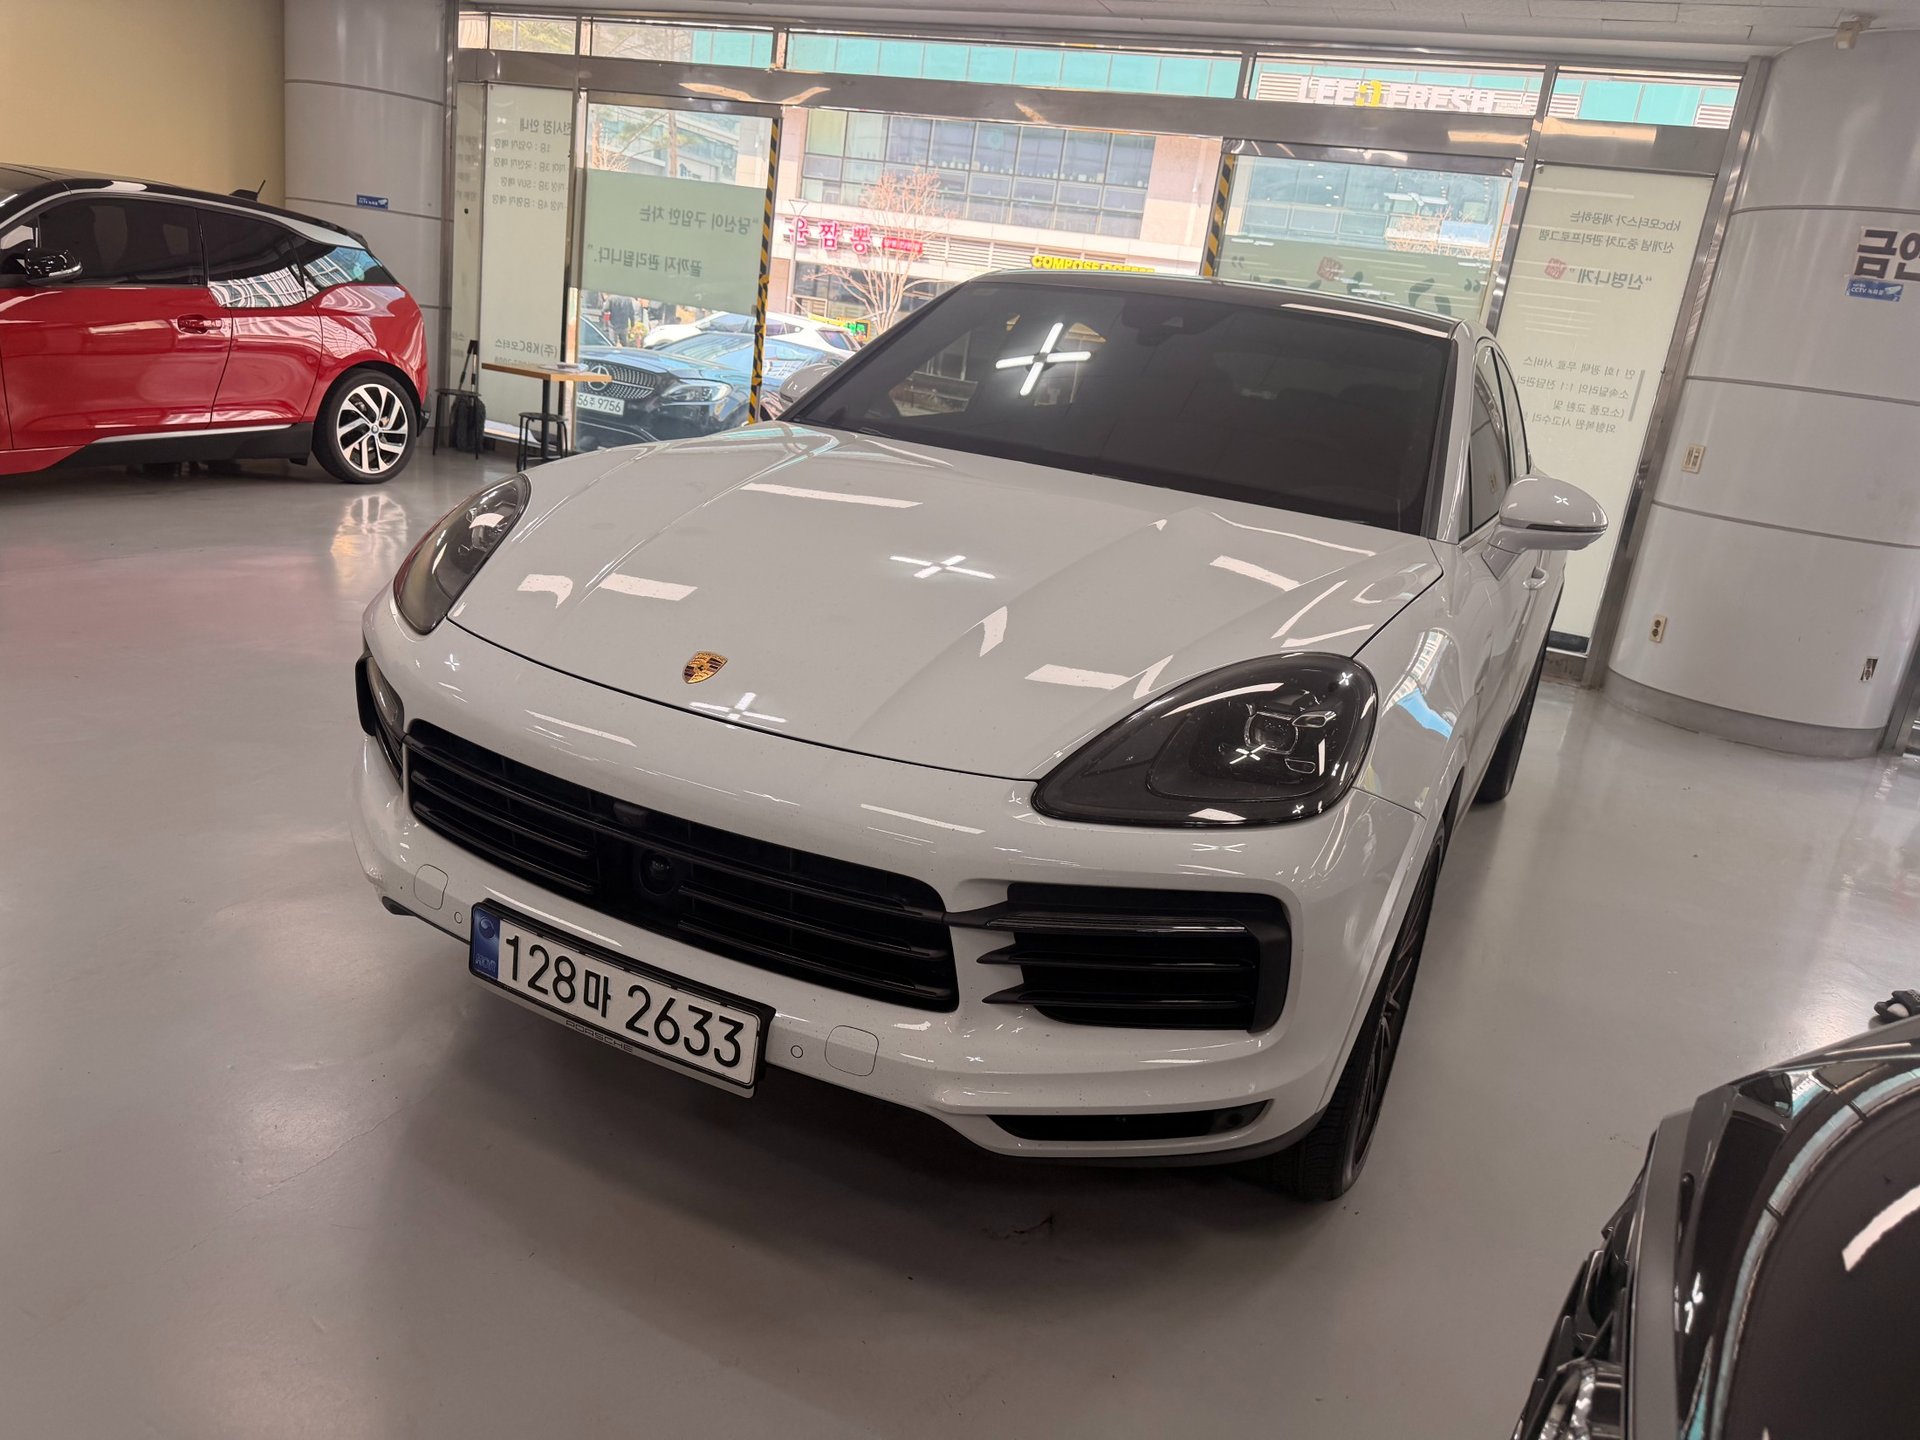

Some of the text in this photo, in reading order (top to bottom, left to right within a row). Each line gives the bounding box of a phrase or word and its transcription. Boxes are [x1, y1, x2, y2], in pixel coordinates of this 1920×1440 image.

[597, 398, 621, 413] 9756
[506, 935, 745, 1068] 128마 2633
[566, 1019, 634, 1053] PORSCHE
